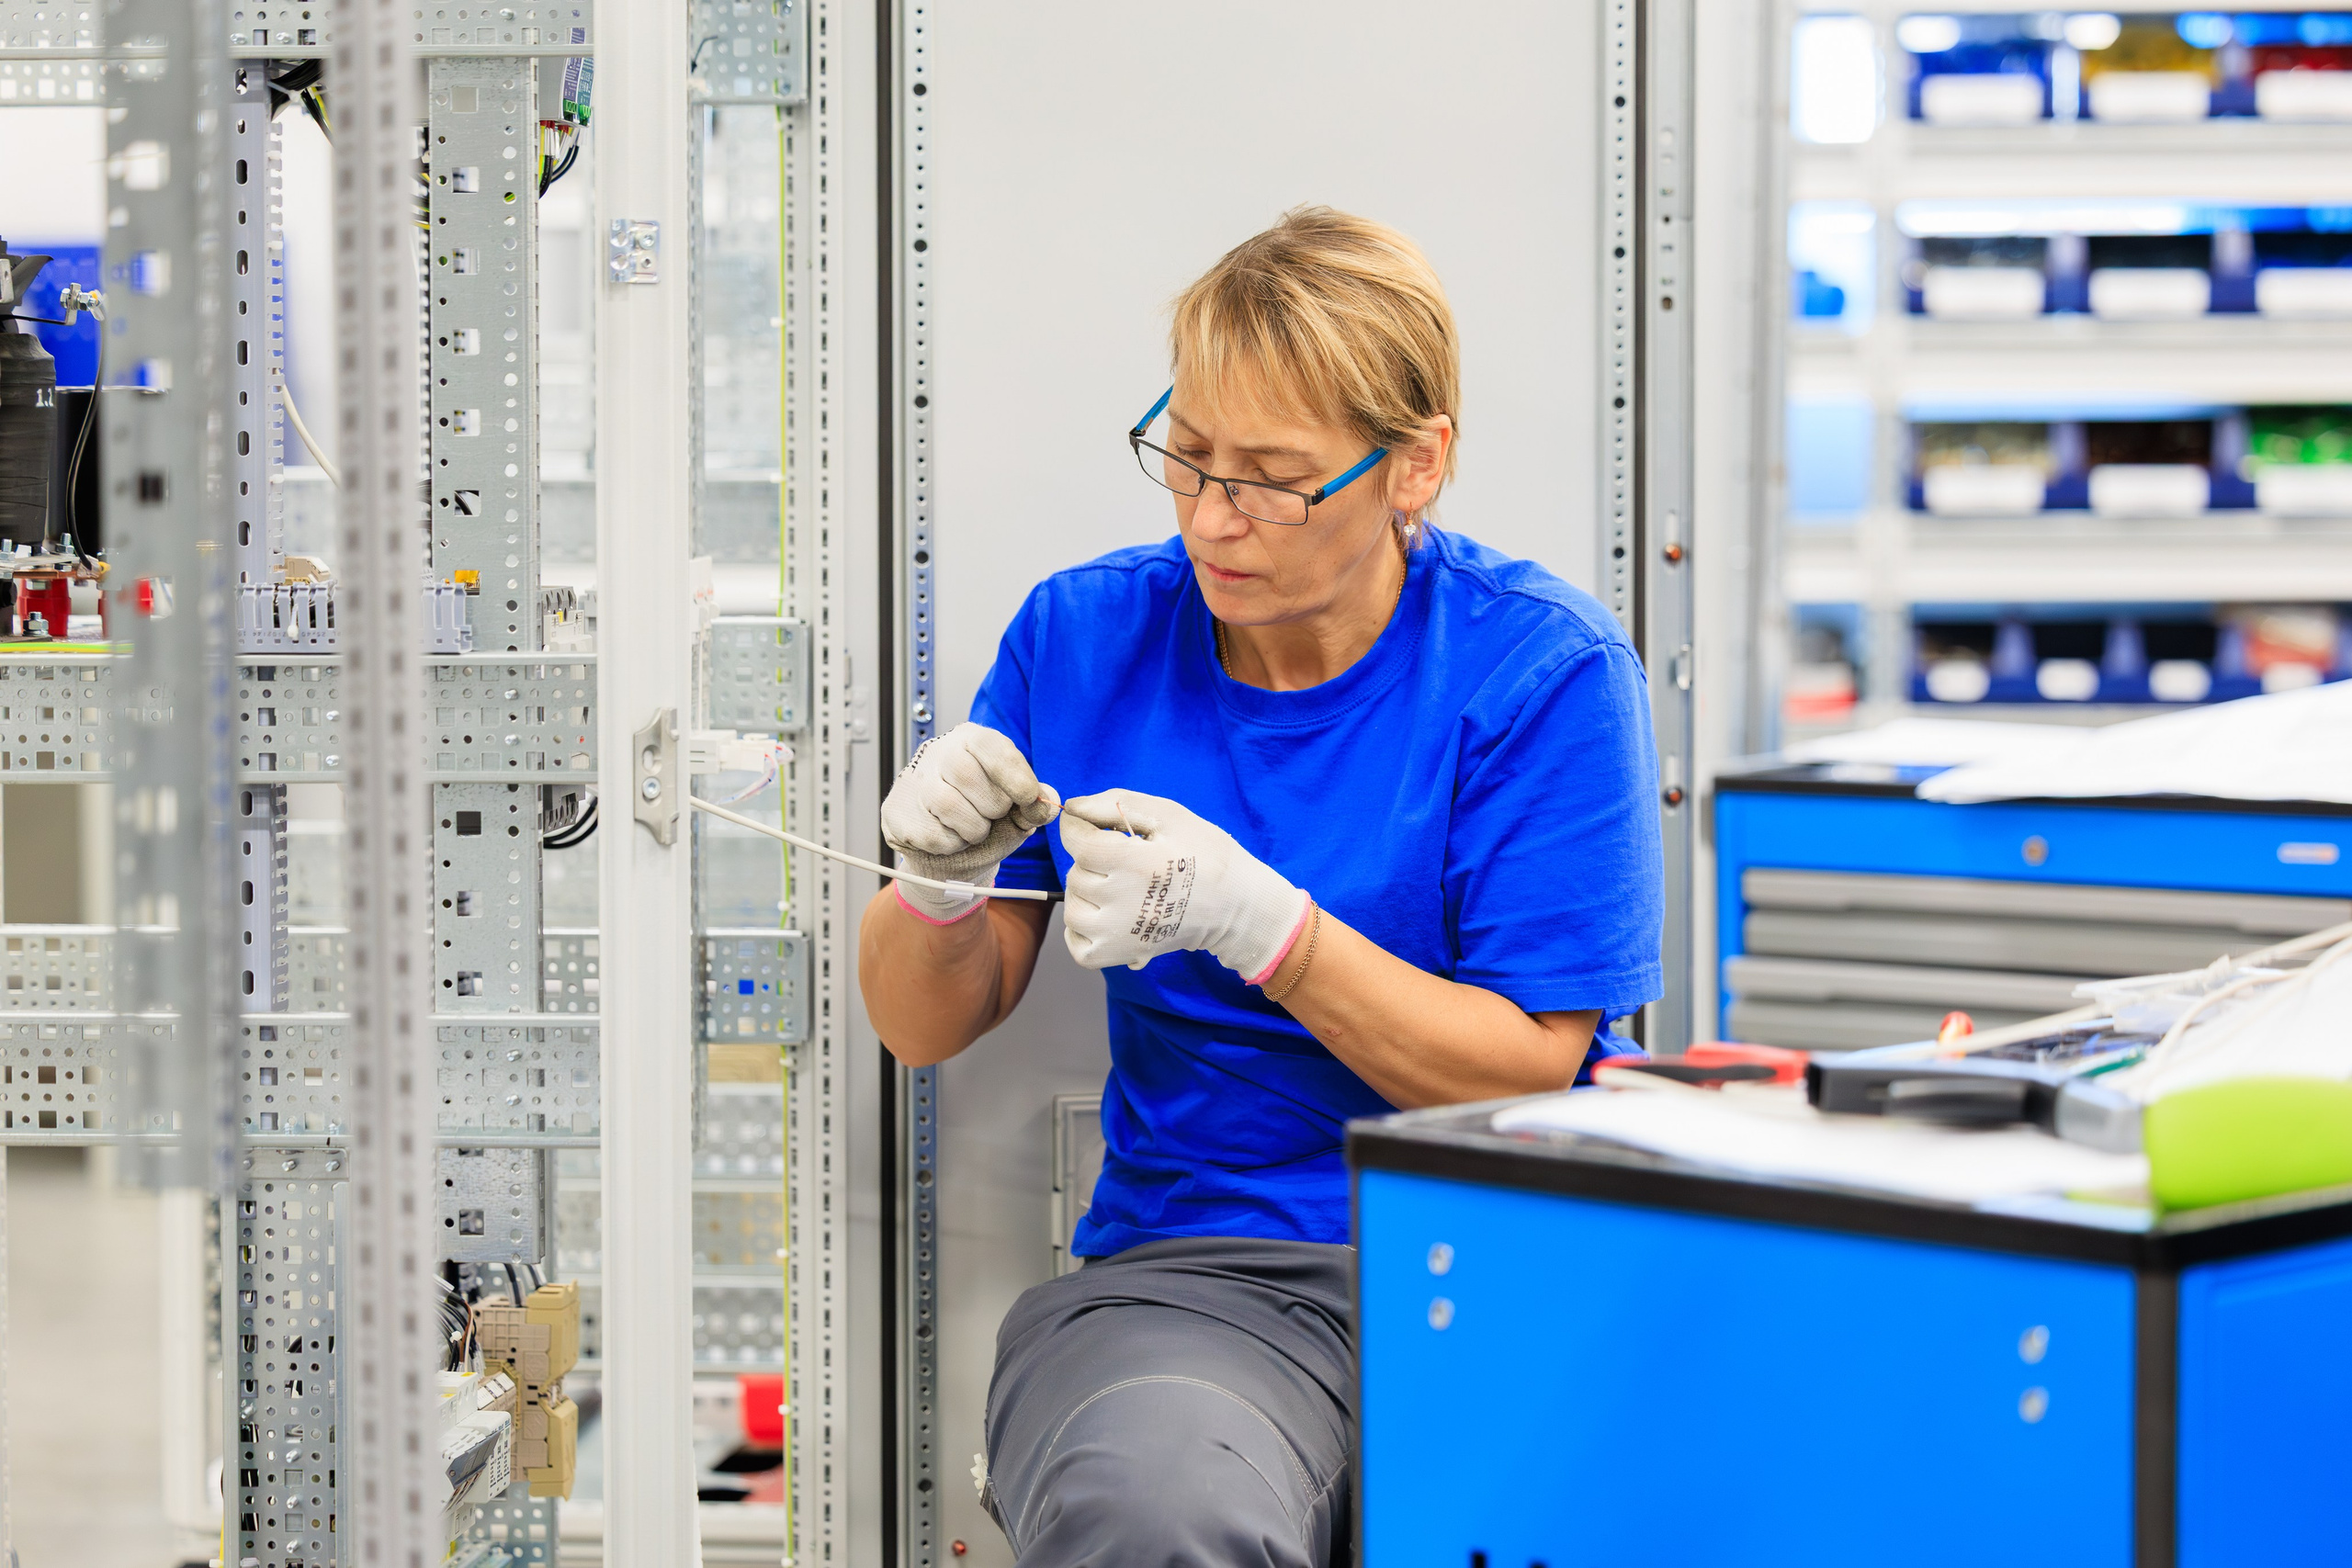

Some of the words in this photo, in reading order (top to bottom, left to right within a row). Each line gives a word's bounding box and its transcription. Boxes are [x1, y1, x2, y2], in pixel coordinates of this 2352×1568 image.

[1177, 858, 1186, 873] 6
[1130, 871, 1161, 935] БАНТИНГ
[1140, 860, 1174, 942] ЭВОЛЮШН
